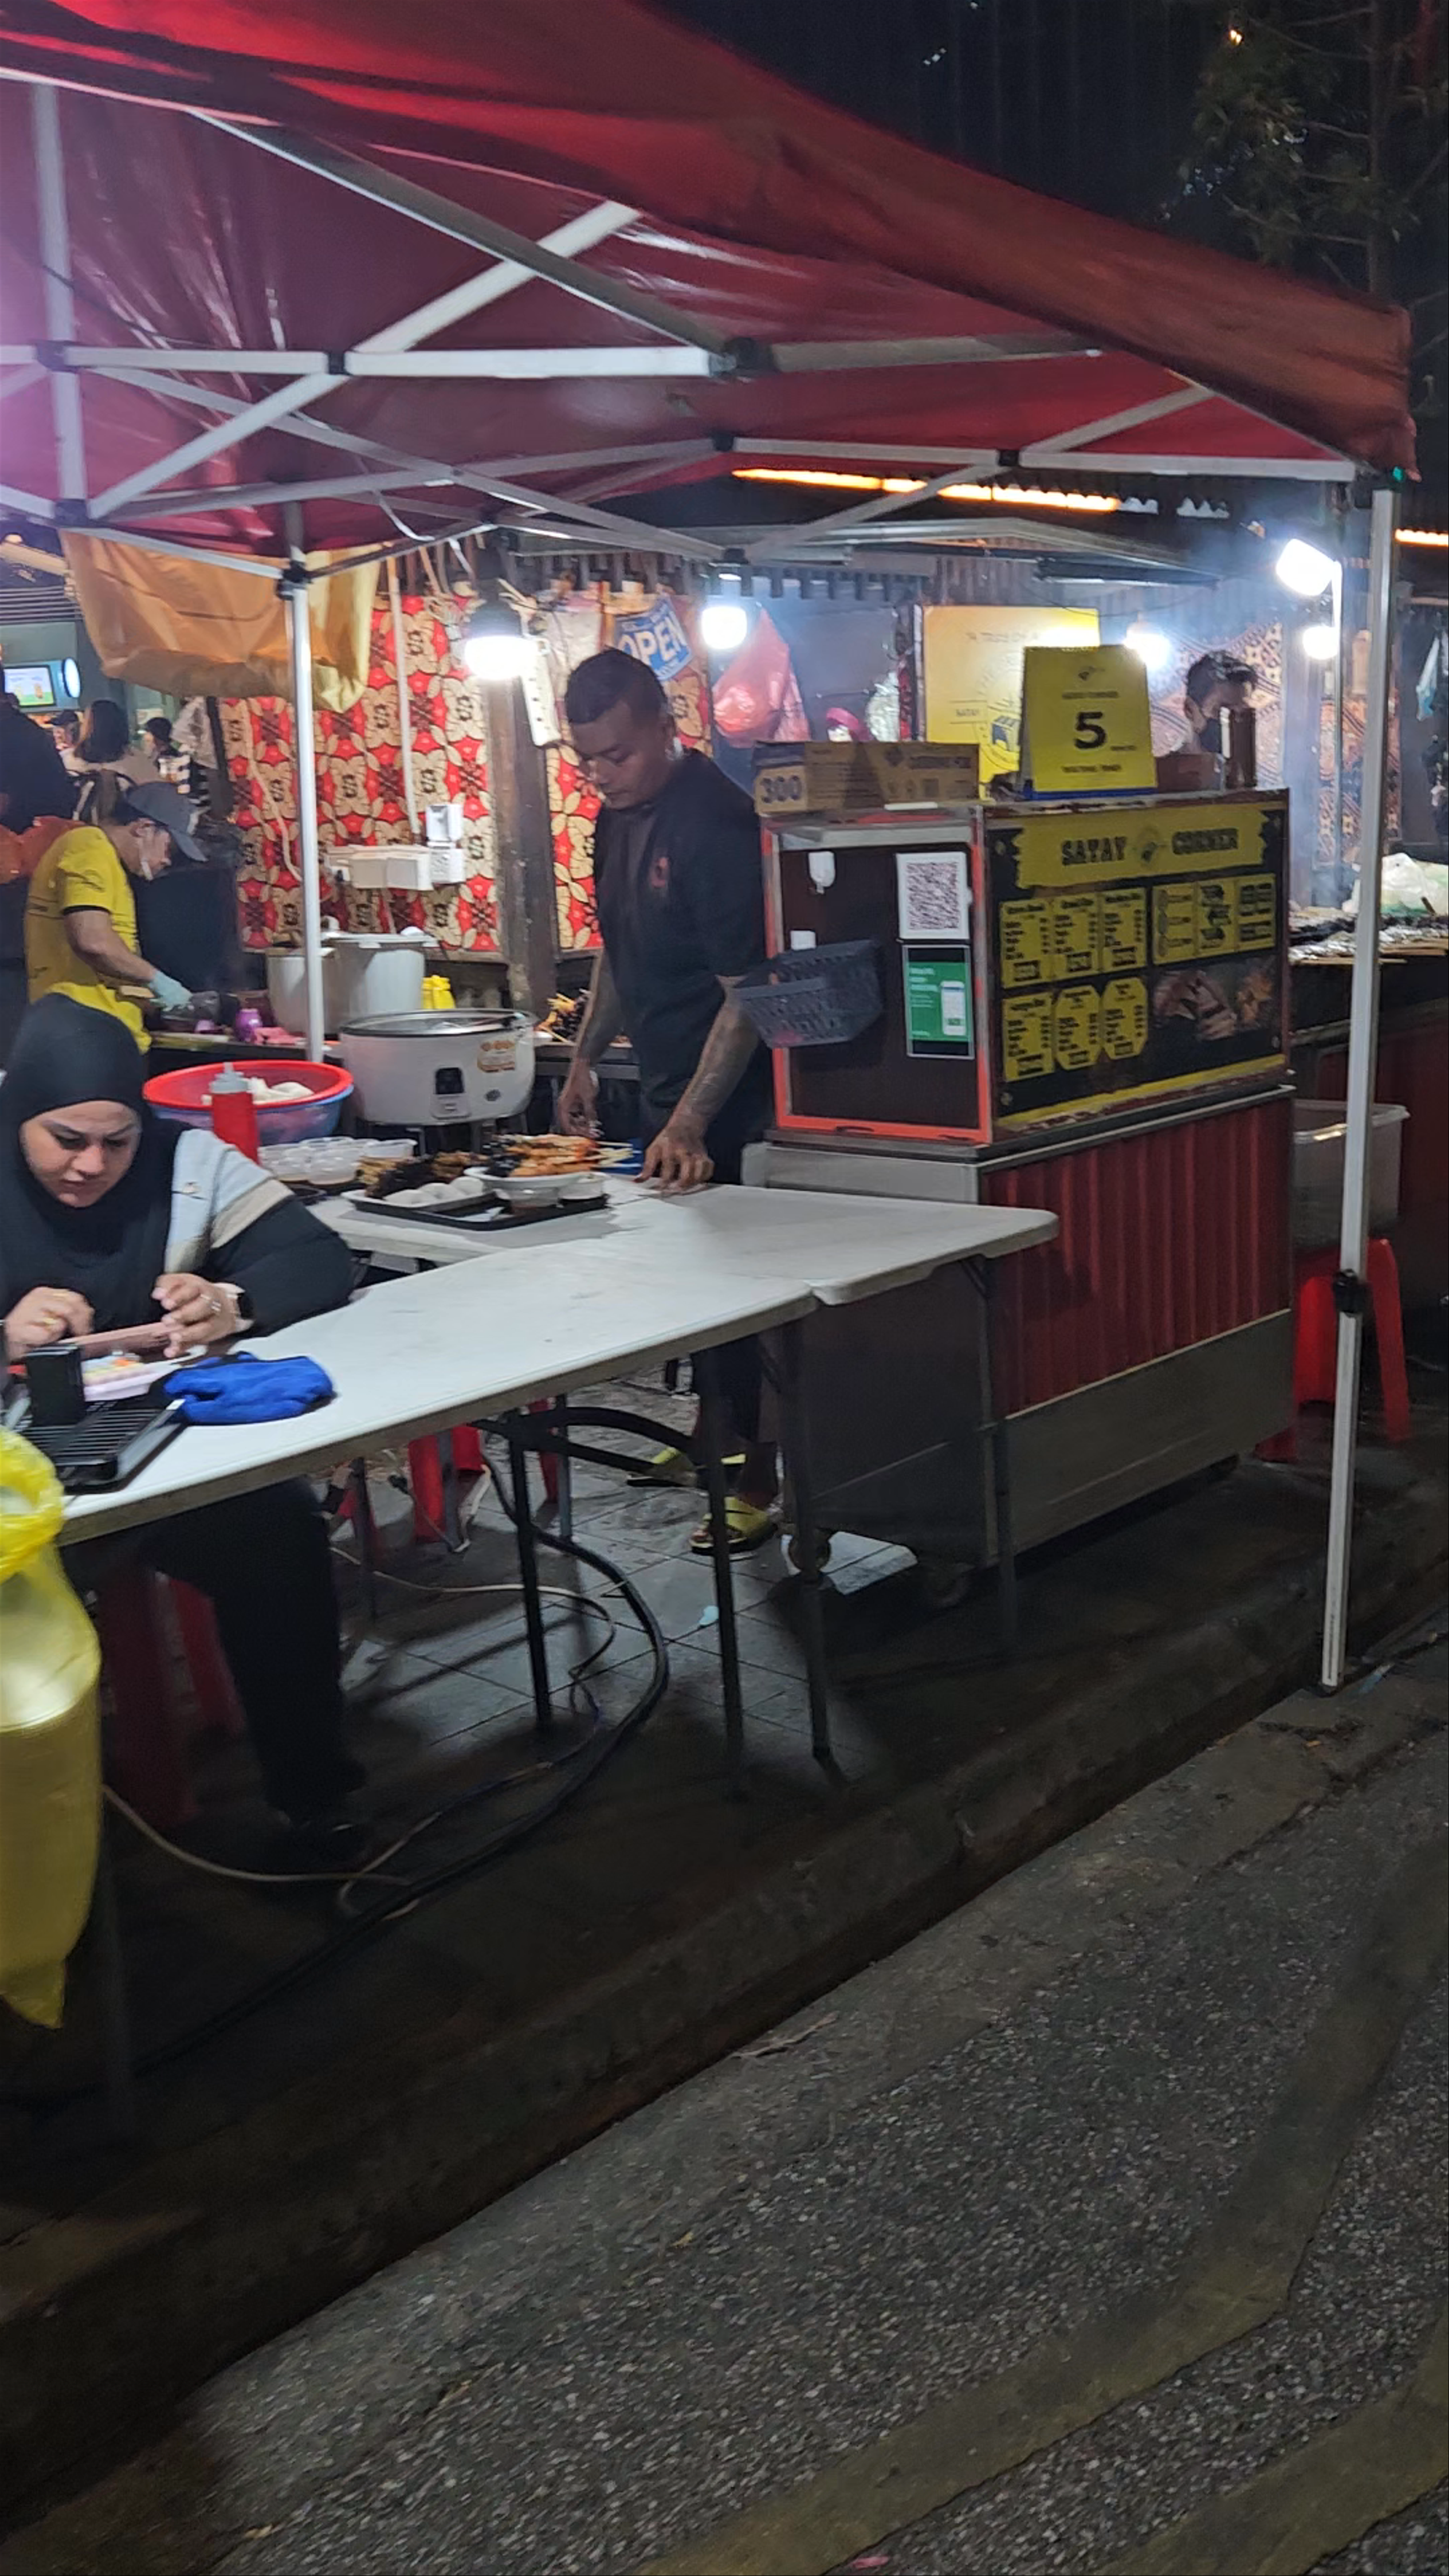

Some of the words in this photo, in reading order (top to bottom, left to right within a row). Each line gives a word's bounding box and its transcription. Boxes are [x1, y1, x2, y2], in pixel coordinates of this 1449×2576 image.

[617, 612, 687, 666] OPEN
[1074, 711, 1106, 749] 5
[1061, 837, 1127, 866] SATAY
